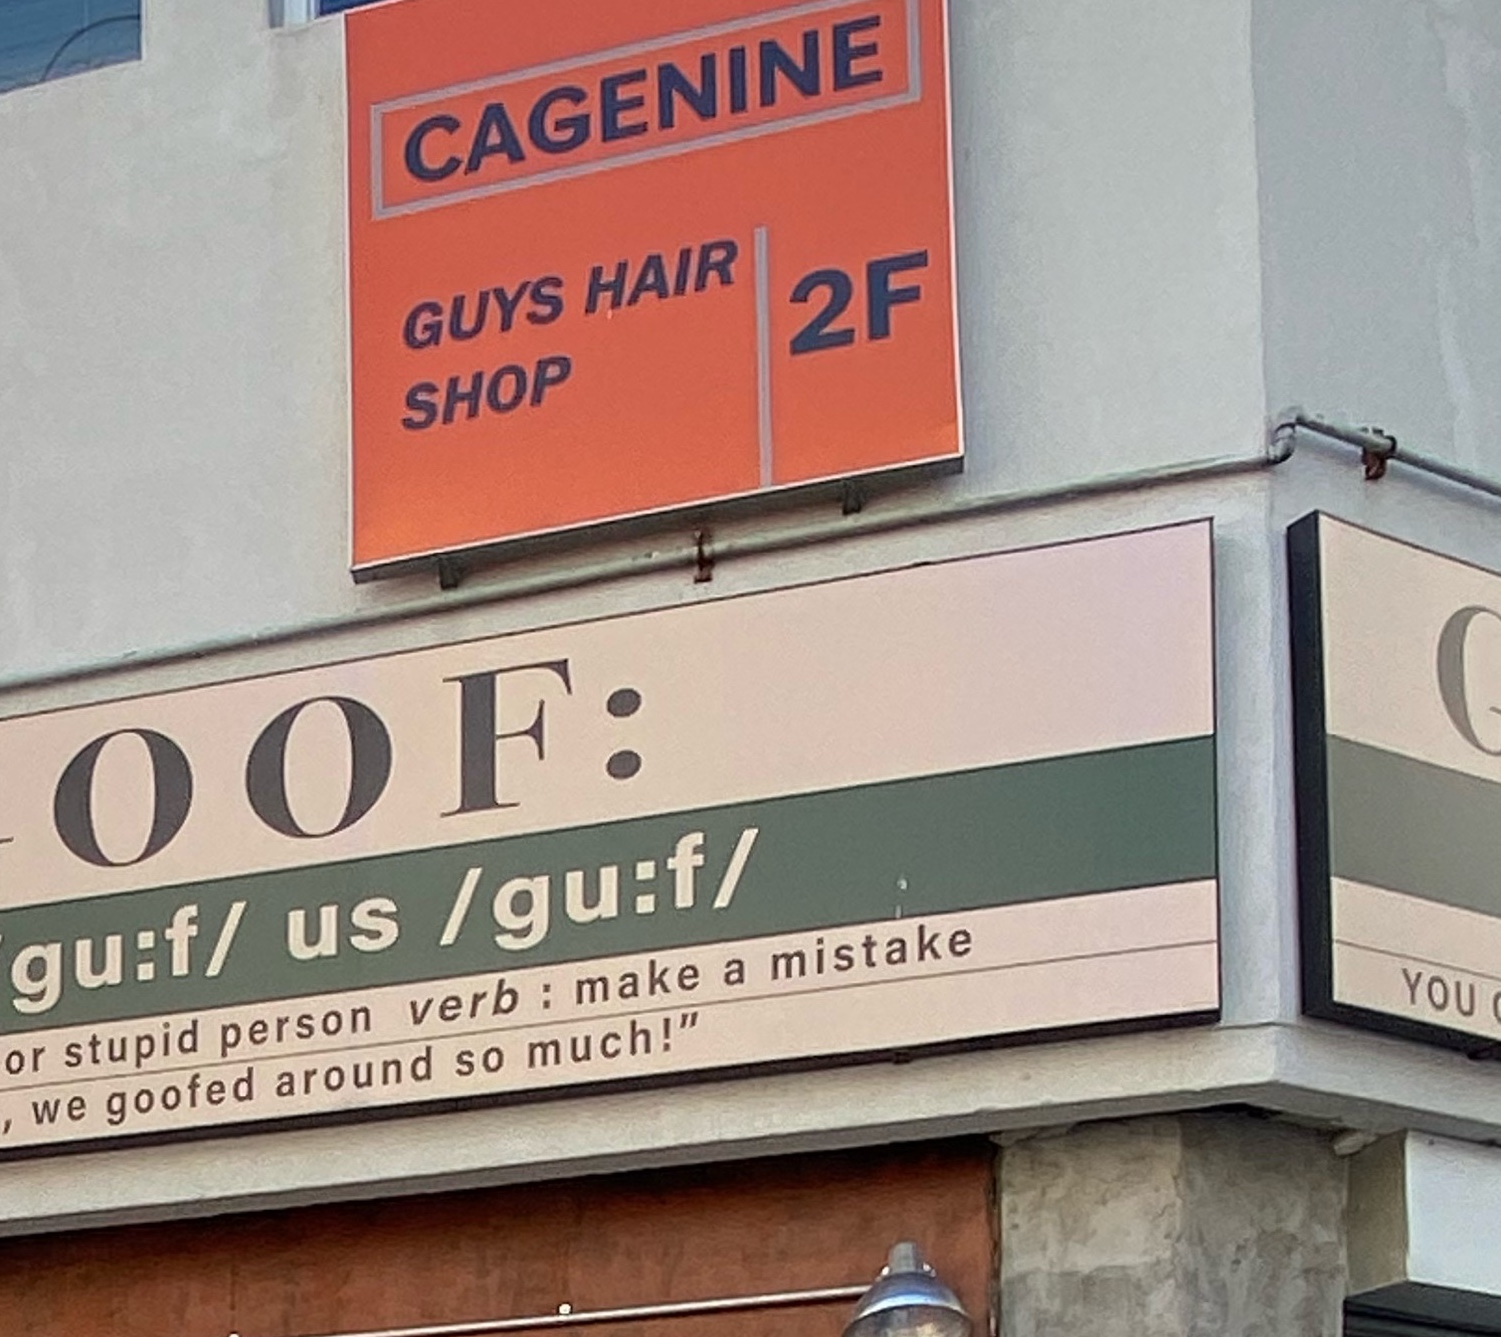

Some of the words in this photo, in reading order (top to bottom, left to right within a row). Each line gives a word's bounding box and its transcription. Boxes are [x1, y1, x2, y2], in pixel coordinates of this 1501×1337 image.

[403, 15, 885, 183] CAGENINE
[402, 276, 564, 350] GUYS
[584, 238, 740, 315] HAIR
[788, 249, 930, 356] 2F
[401, 355, 573, 432] SHOP
[286, 895, 401, 962] us
[440, 827, 762, 952] /gu:f/
[4, 1046, 47, 1076] or
[64, 1019, 201, 1069] stupid
[220, 1003, 372, 1057] person
[409, 978, 520, 1027] verb
[575, 958, 702, 1007] make
[723, 955, 746, 986] a
[770, 922, 973, 982] mistake
[1401, 967, 1476, 1018] YOU
[32, 1093, 89, 1126] we
[105, 1065, 256, 1126] goofed
[275, 1046, 433, 1101] around
[455, 1047, 506, 1077] so
